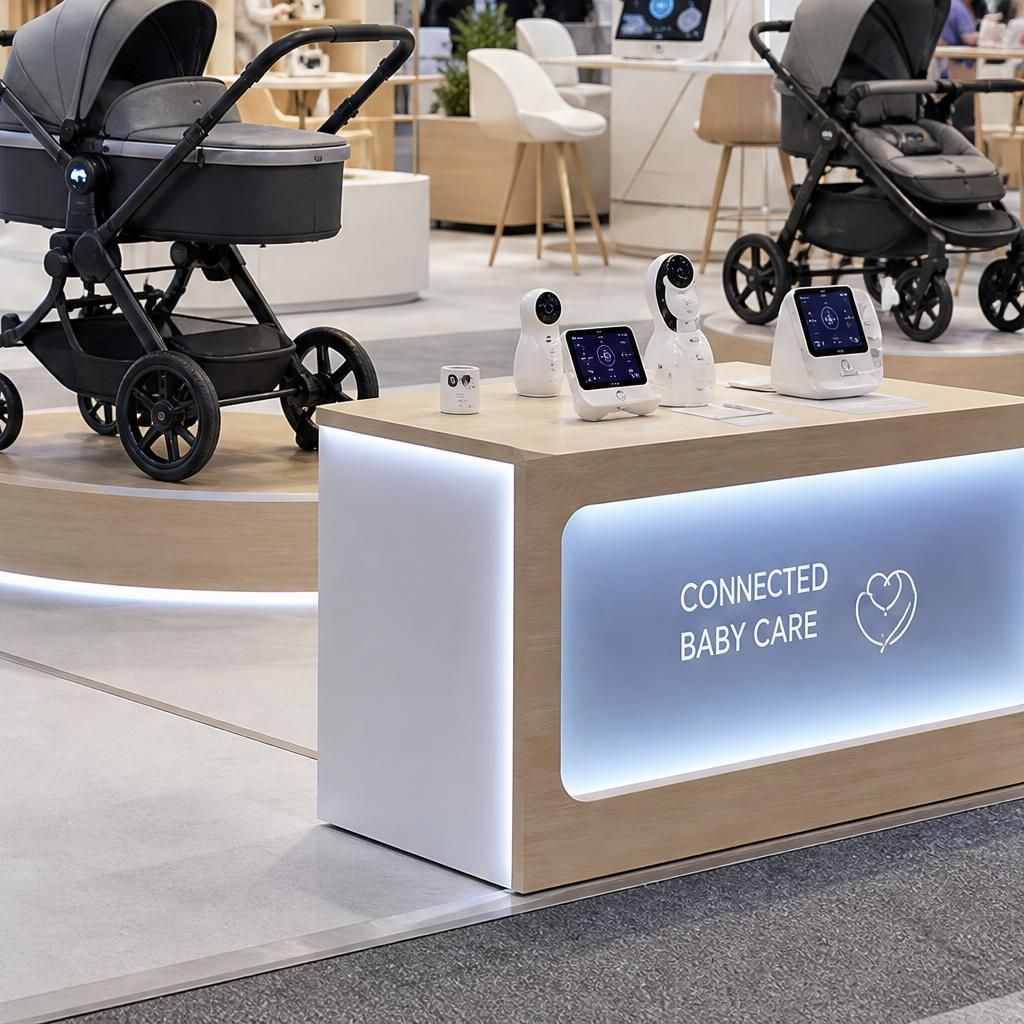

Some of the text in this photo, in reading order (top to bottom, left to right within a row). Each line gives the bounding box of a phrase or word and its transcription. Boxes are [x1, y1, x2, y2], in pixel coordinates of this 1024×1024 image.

[680, 562, 829, 613] CONNECTED
[680, 609, 818, 662] BABY CARE
